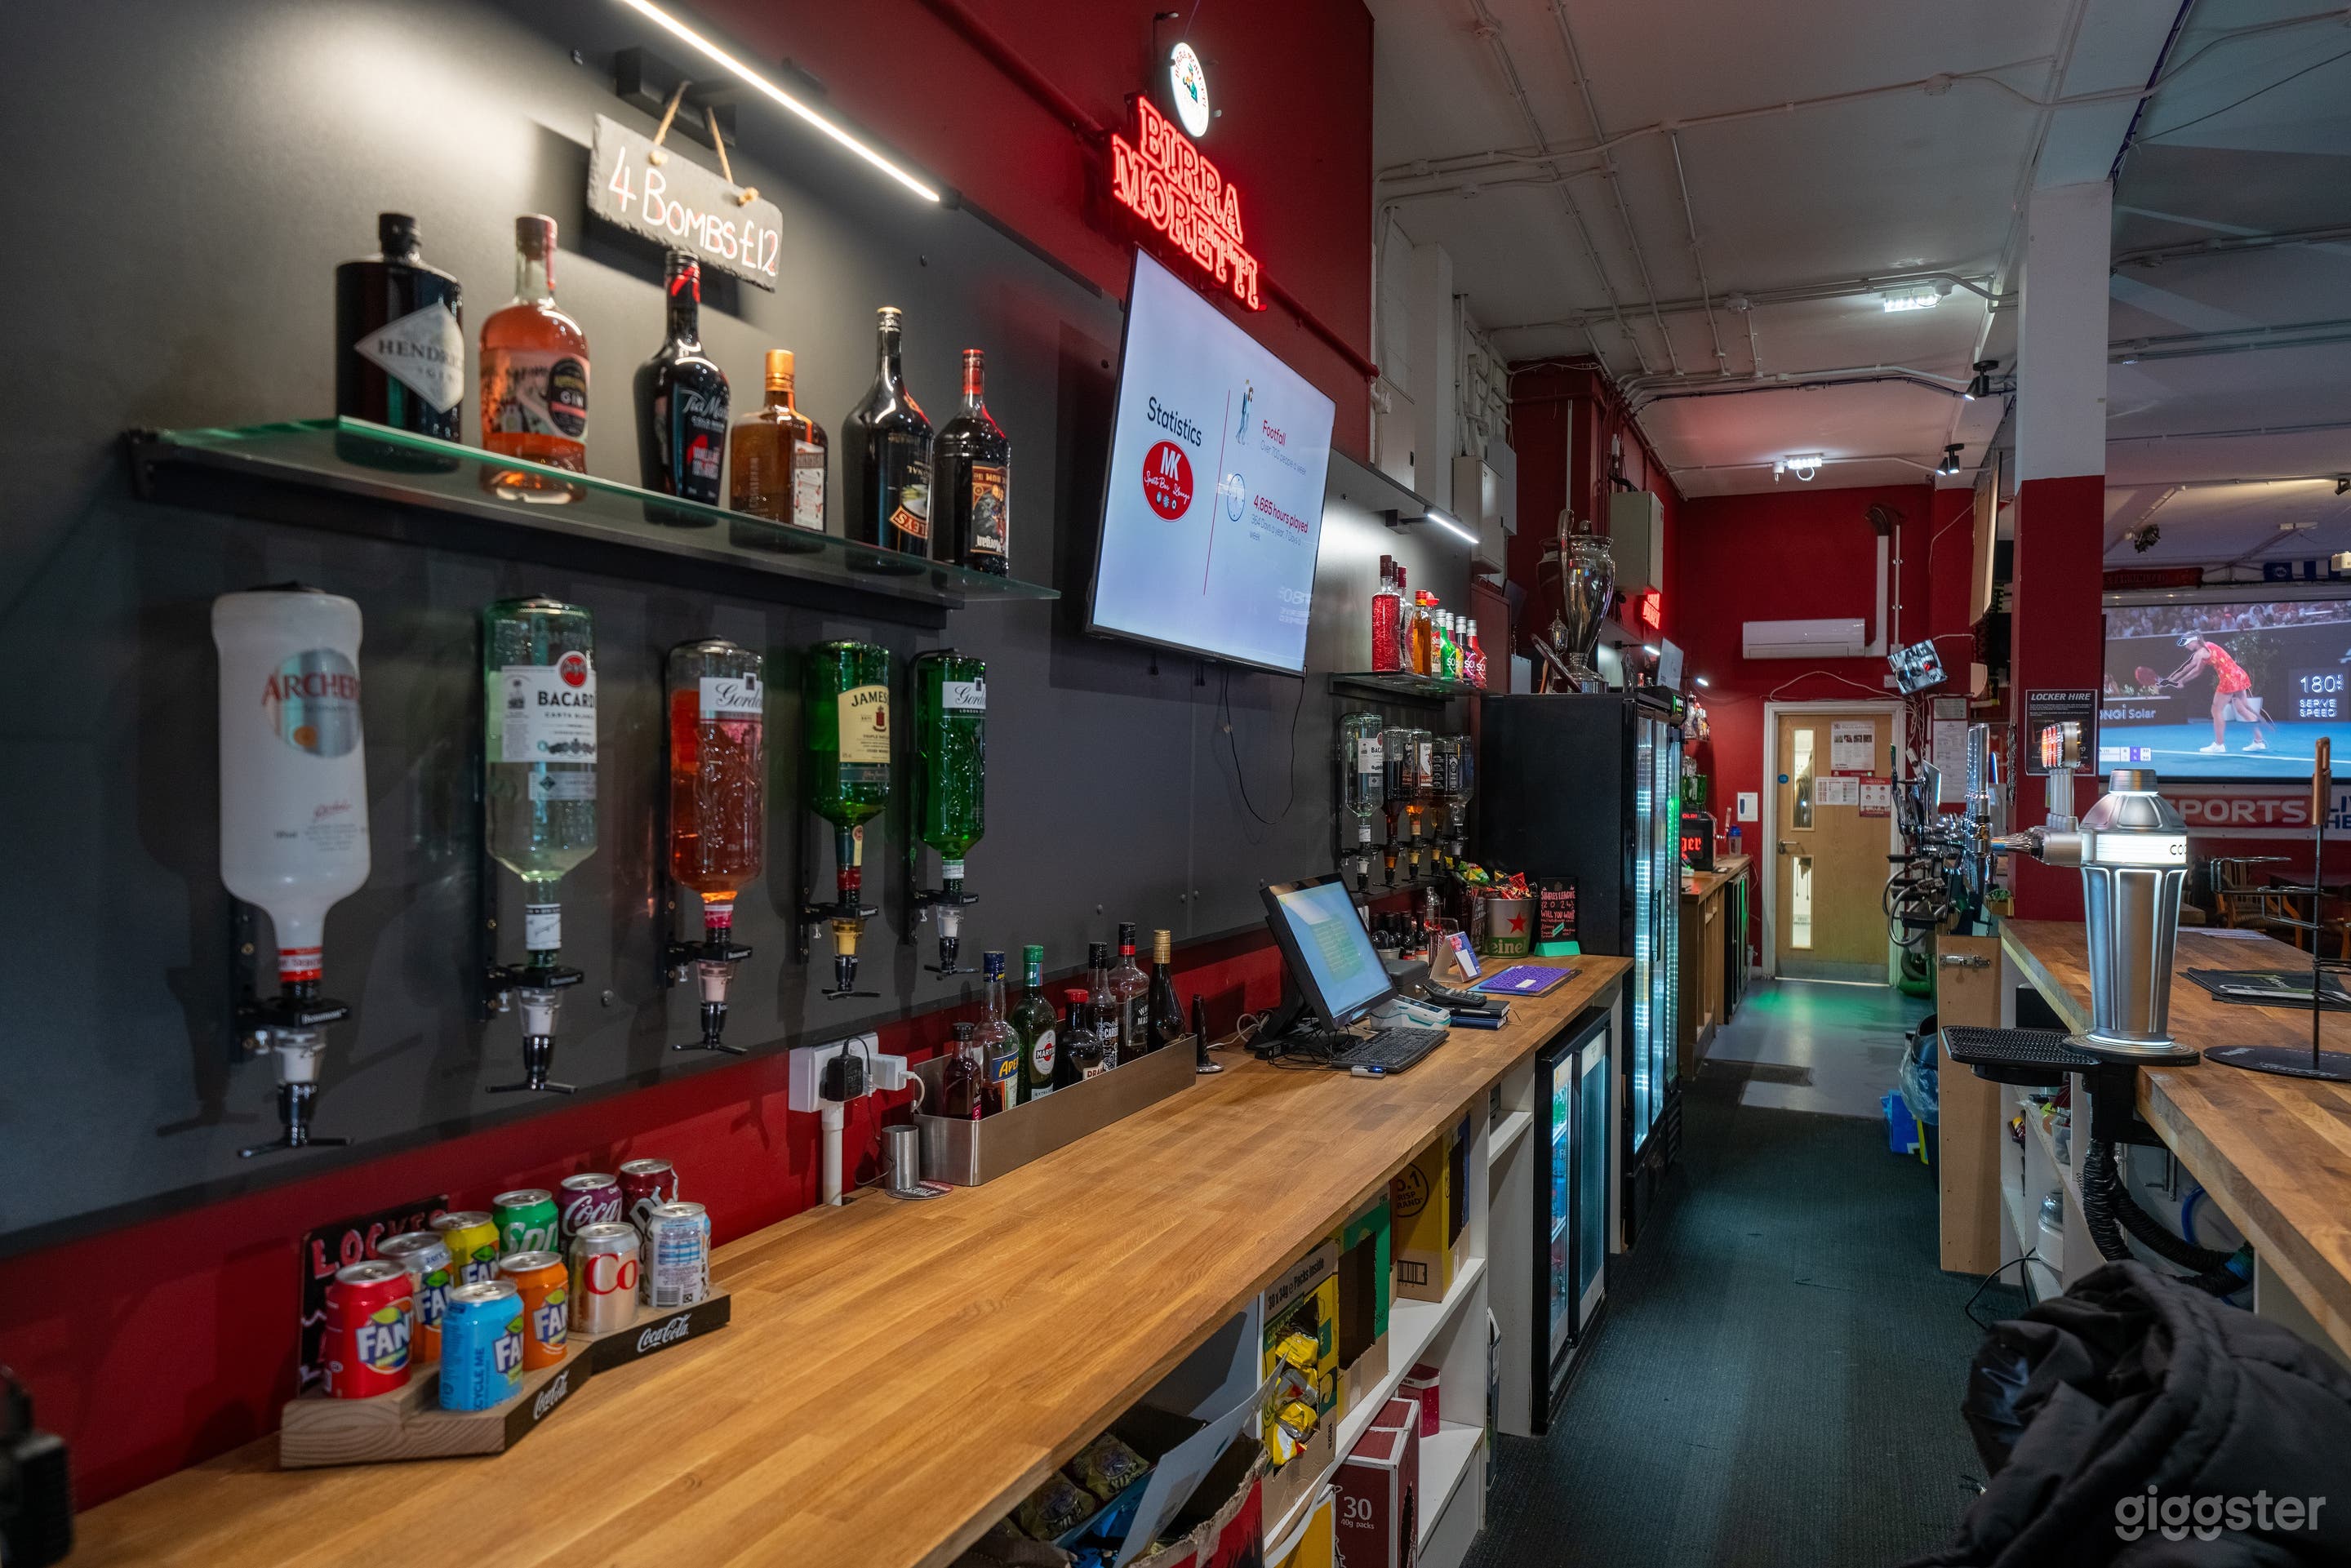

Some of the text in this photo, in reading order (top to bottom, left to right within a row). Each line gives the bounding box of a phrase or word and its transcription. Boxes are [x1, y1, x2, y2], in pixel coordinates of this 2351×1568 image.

[1139, 96, 1244, 244] BIRRA
[608, 145, 637, 213] 4
[741, 220, 780, 278] £12
[1112, 133, 1260, 310] MORETTI
[1147, 396, 1202, 446] Statistics
[1262, 420, 1287, 446] Footfall
[1160, 446, 1181, 481] MK
[1273, 504, 1289, 524] hours
[1289, 517, 1309, 533] played
[2300, 675, 2335, 693] 180
[2031, 693, 2067, 701] LOCKER
[2300, 699, 2336, 708] SERVE
[2128, 708, 2156, 719] Solar
[2300, 708, 2336, 717] SPEED
[2178, 799, 2307, 824] PORTS
[1398, 1191, 1415, 1201] RISP
[1398, 1197, 1420, 1209] RAND
[1294, 1268, 1309, 1290] Packs
[1309, 1258, 1324, 1277] Inside
[1344, 1496, 1372, 1521] 30
[1340, 1519, 1375, 1530] 40g packs
